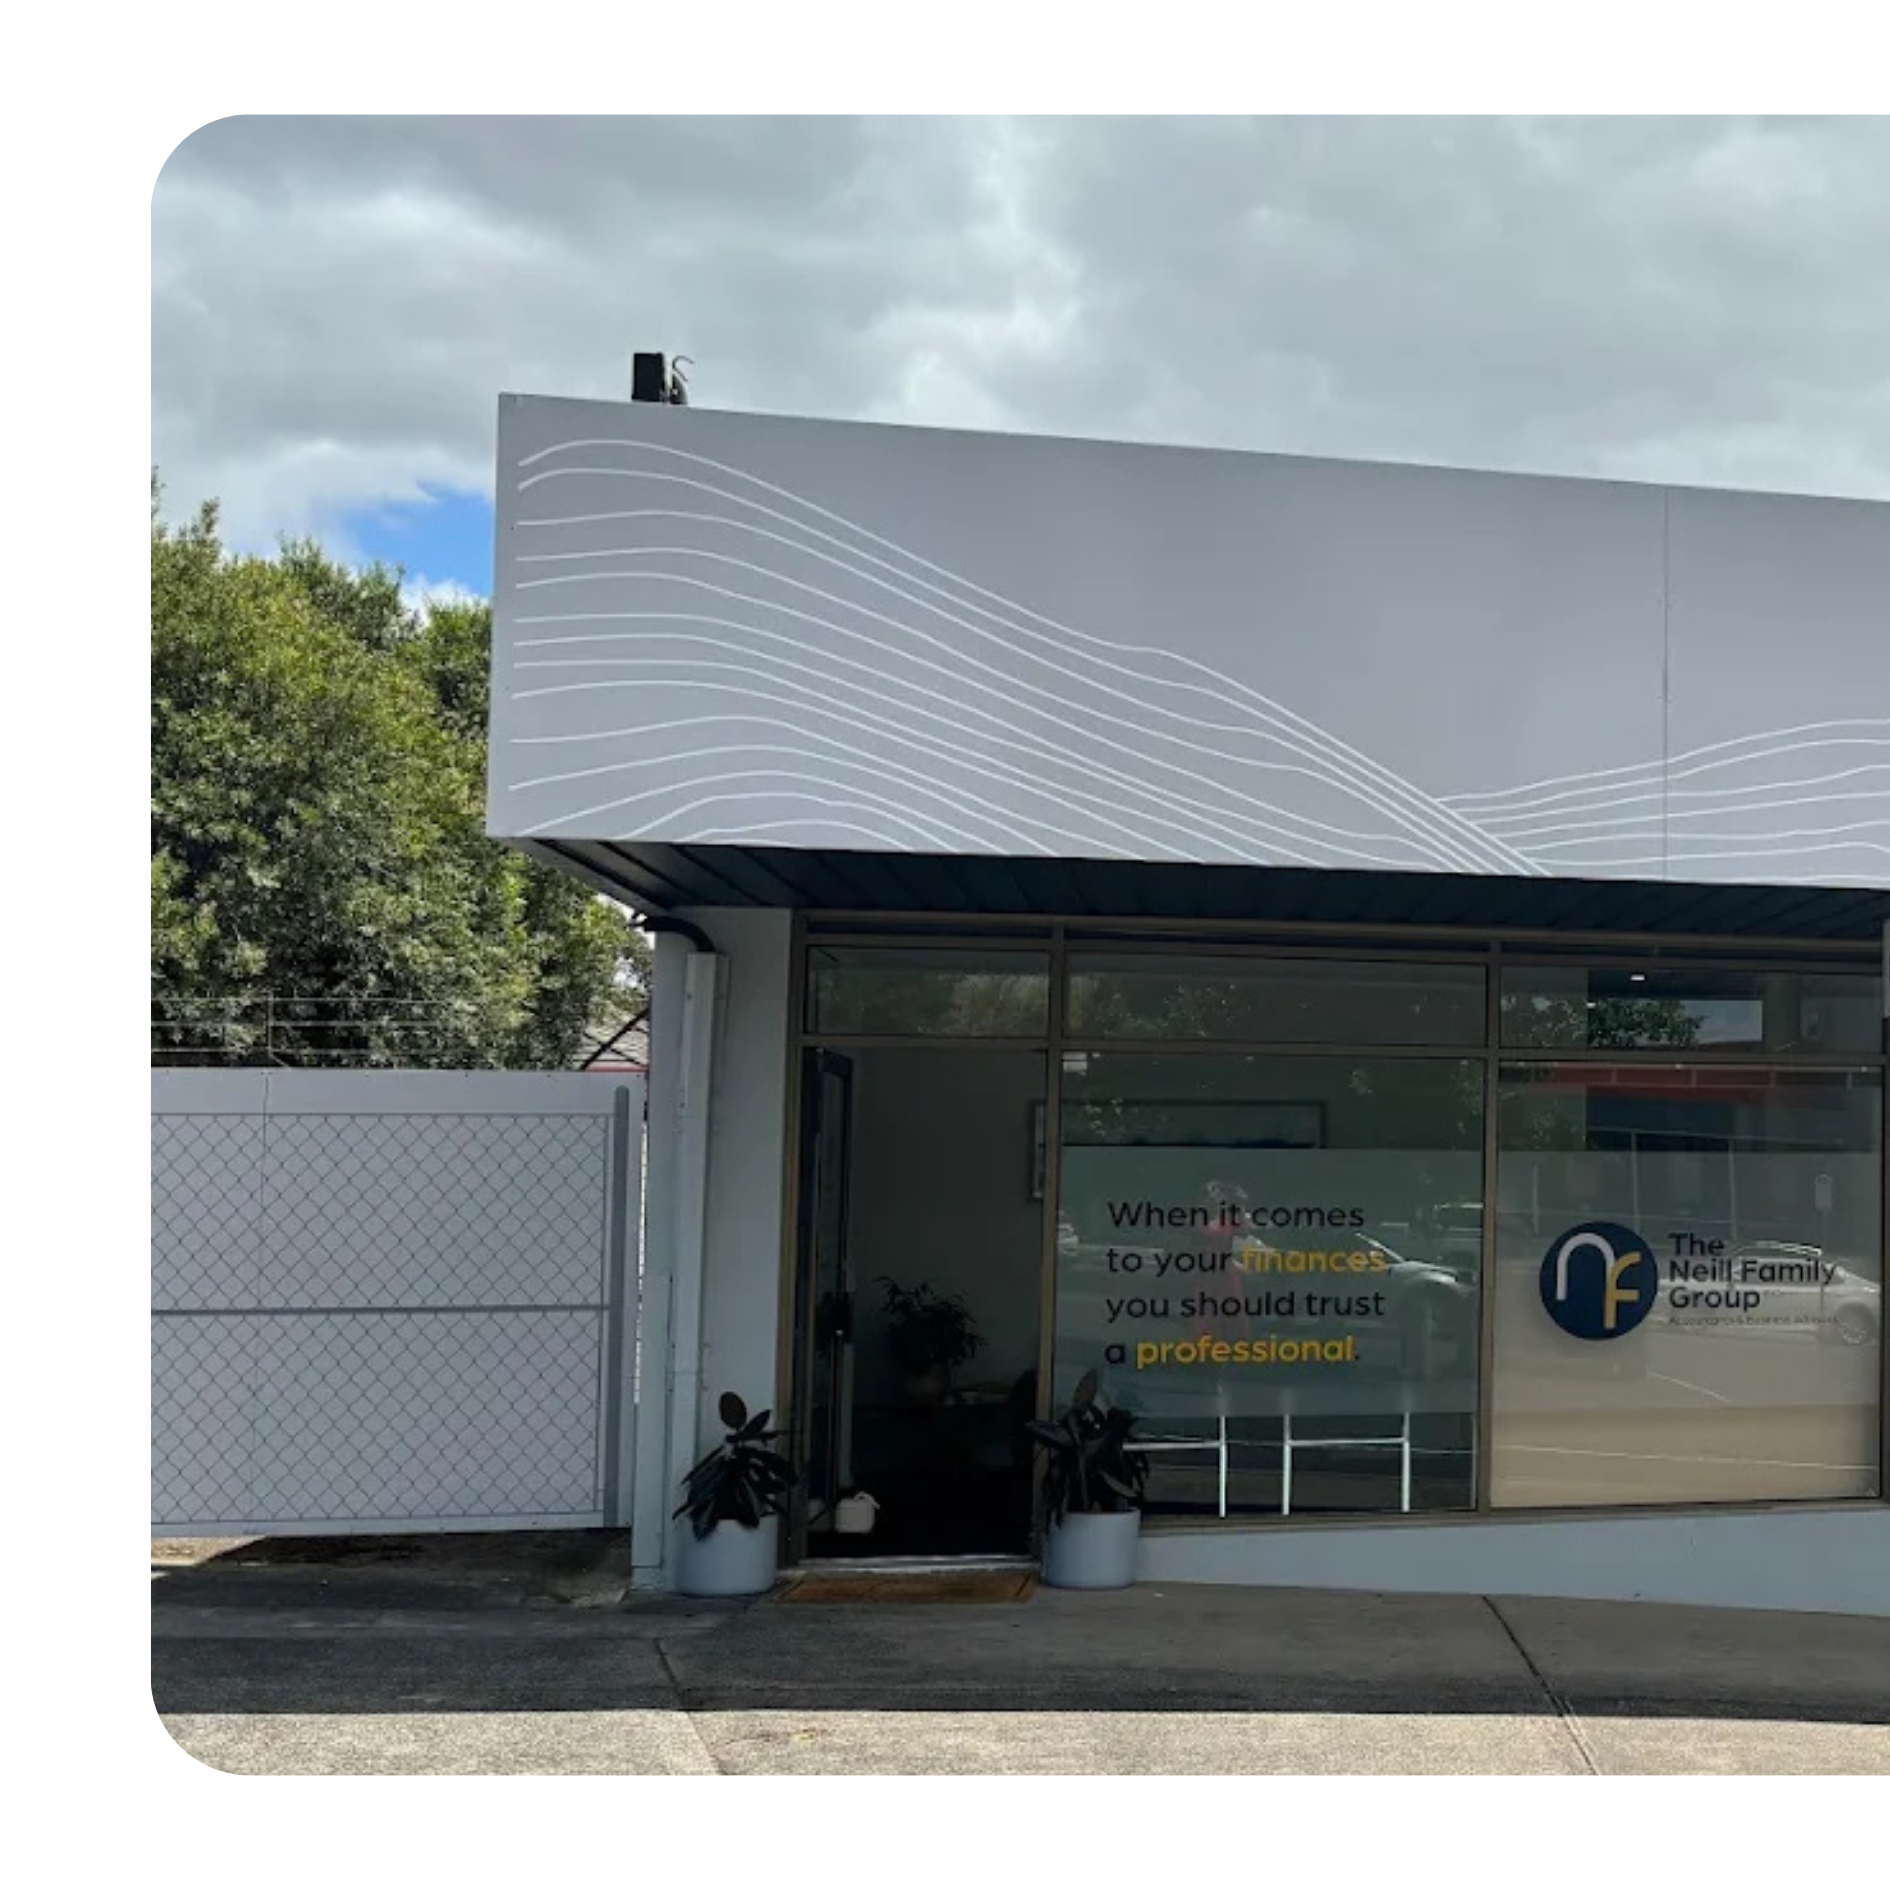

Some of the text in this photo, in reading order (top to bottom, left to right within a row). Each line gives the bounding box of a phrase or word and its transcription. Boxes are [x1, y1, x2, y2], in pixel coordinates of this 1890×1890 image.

[1107, 1200, 1365, 1228] When it comes
[1667, 1233, 1725, 1257] The
[1106, 1247, 1143, 1273] to
[1149, 1251, 1234, 1278] your
[1668, 1259, 1837, 1286] Neill Family
[1105, 1291, 1386, 1323] you should trust
[1668, 1286, 1762, 1312] Group
[1103, 1334, 1360, 1370] a professional.
